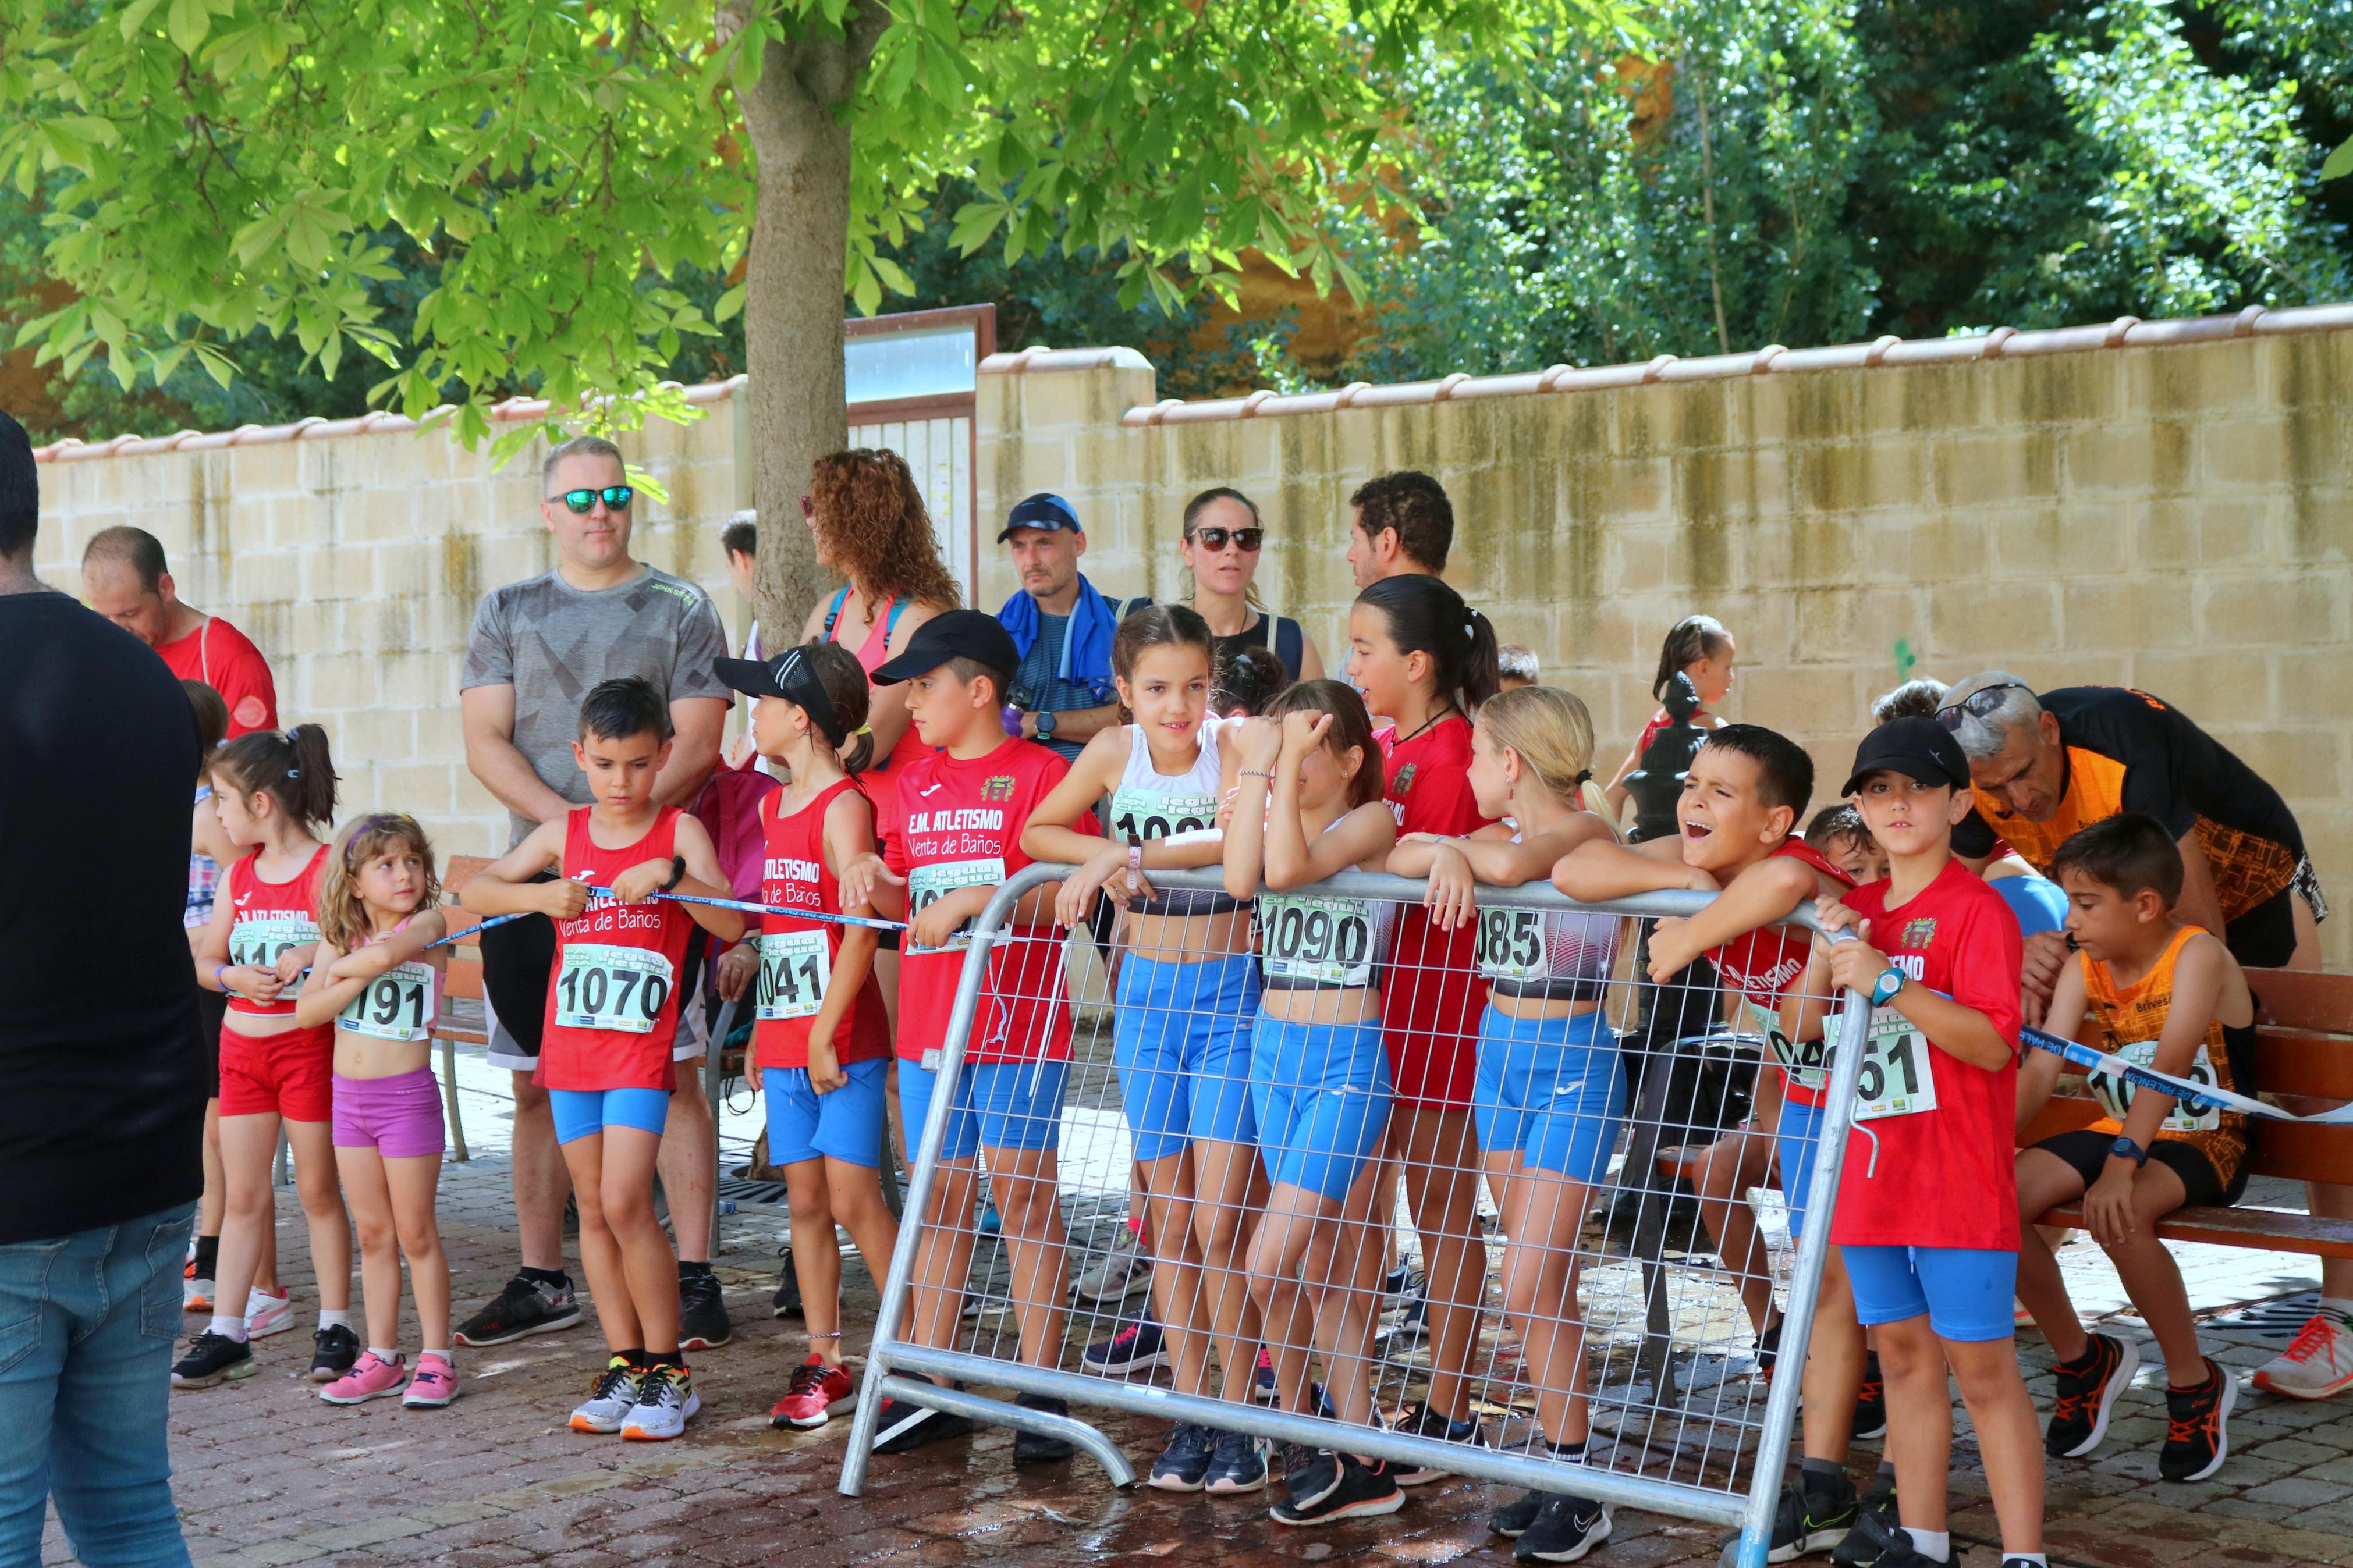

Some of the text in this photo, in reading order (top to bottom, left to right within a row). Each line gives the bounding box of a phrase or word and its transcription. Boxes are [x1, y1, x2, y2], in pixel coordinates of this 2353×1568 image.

[1116, 798, 1146, 806] LEN
[1116, 804, 1147, 813] CIA
[1167, 805, 1216, 816] legu
[908, 809, 1003, 834] E.M. ATLETISMO
[908, 833, 1002, 858] Venta de Baños
[765, 858, 820, 884] ATLETISMO
[931, 865, 992, 877] legua
[936, 873, 999, 886] legua
[770, 883, 782, 904] de
[786, 882, 822, 907] Baños
[559, 909, 661, 938] Venta de Baños
[766, 937, 816, 948] legua
[1265, 905, 1368, 969] 1090
[603, 950, 665, 966] legua
[607, 958, 669, 976] legua
[560, 967, 668, 1021] 1070
[2019, 1030, 2062, 1055] DE PALE
[2125, 1071, 2194, 1101] DE PALENCIA
